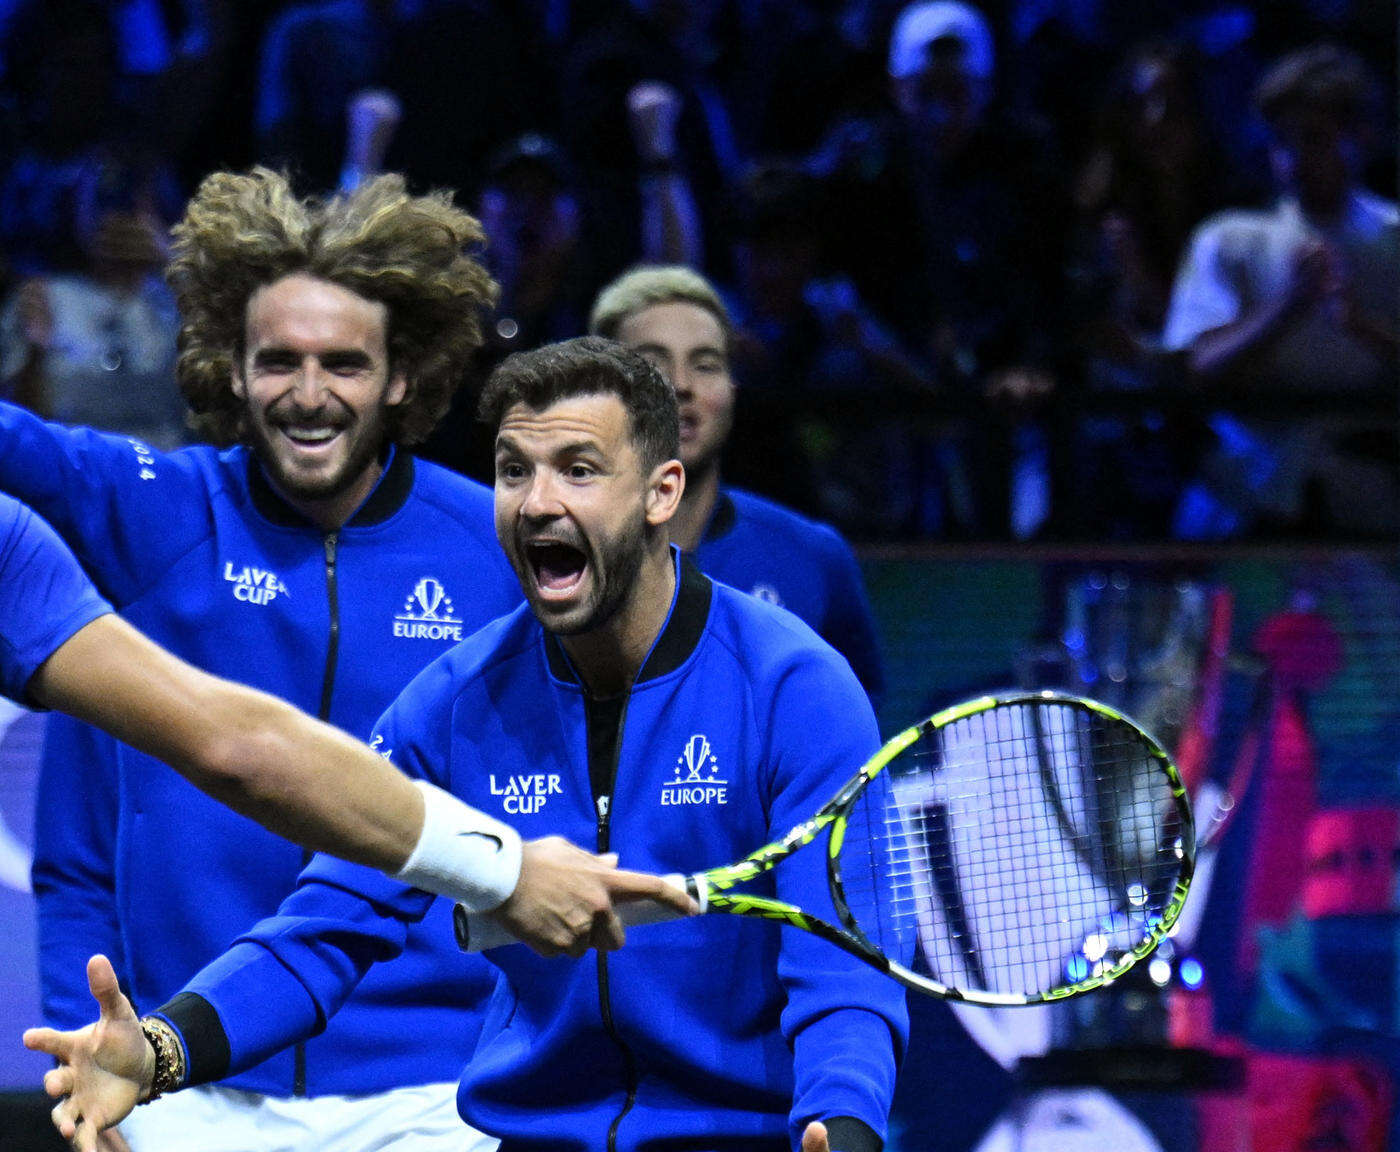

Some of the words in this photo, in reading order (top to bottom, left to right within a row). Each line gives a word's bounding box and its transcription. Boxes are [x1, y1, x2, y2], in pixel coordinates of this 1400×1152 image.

[233, 583, 277, 606] CUP
[392, 621, 463, 642] EUROPE
[489, 773, 564, 796] LAVER
[503, 795, 546, 815] CUP
[660, 787, 729, 806] EUROPE
